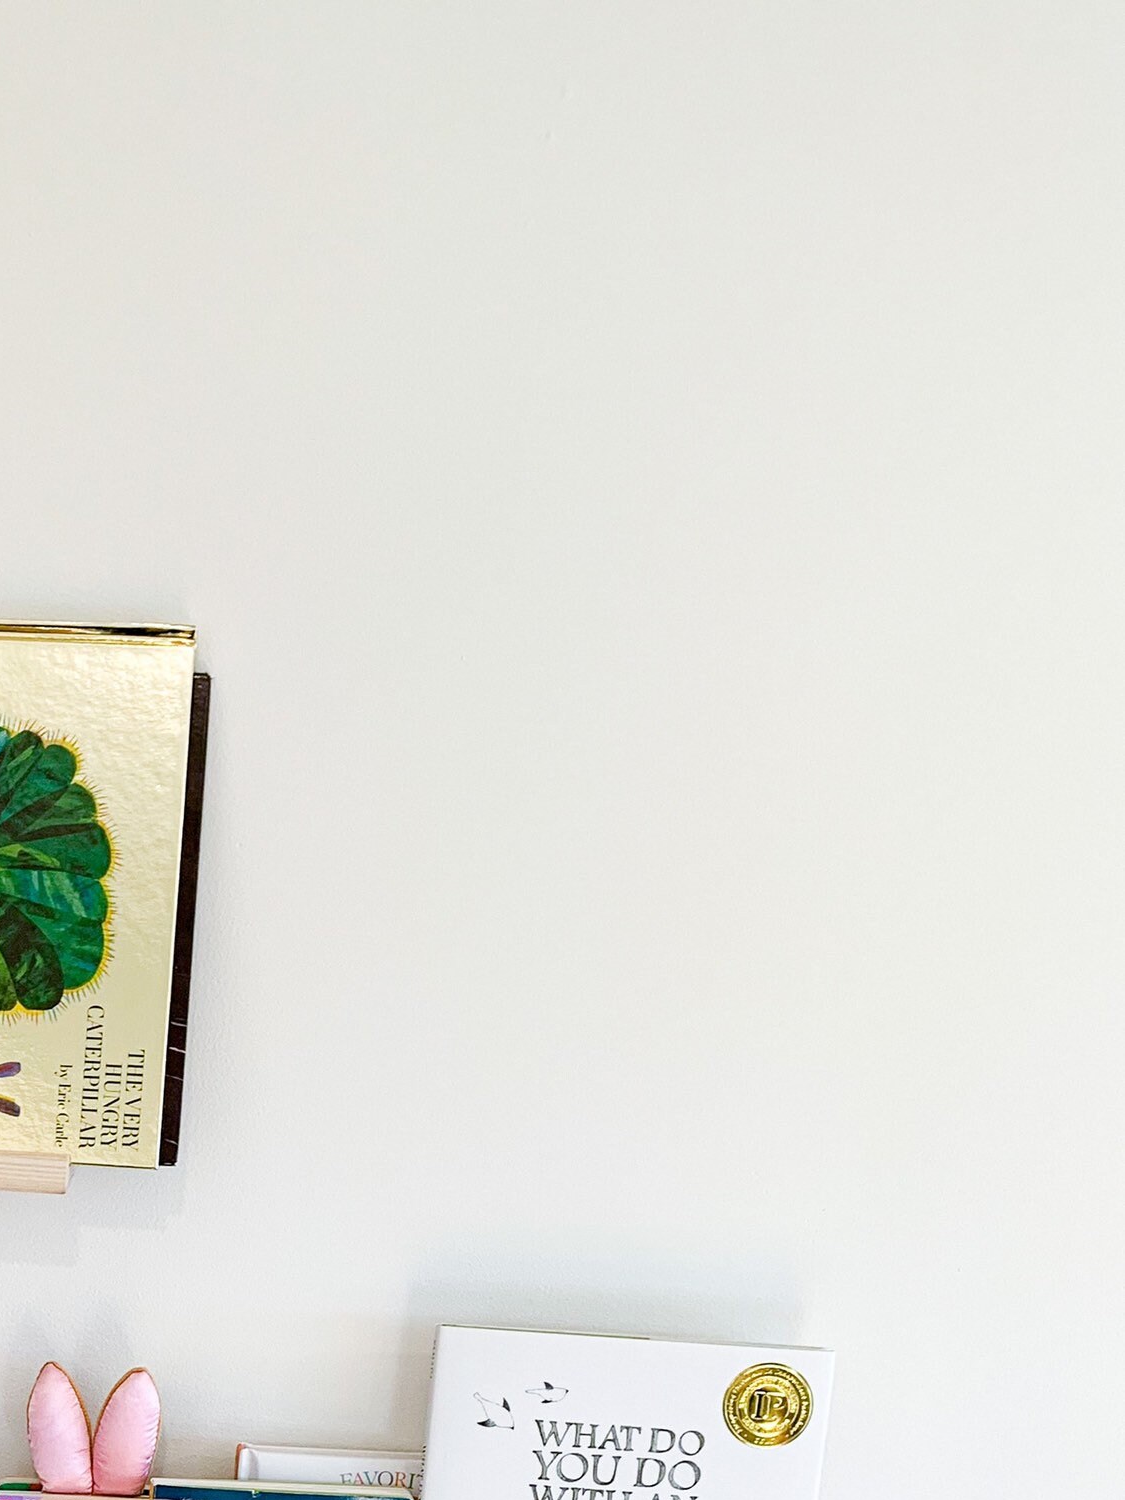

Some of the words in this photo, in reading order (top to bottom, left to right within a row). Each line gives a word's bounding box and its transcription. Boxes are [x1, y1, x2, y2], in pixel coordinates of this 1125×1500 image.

[54, 1064, 73, 1079] by
[78, 1004, 106, 1149] CATERPILLAR
[124, 1049, 146, 1093] THE
[57, 1084, 72, 1109] Eric
[99, 1063, 123, 1151] HUNGRY
[55, 1112, 70, 1148] Carle
[121, 1097, 142, 1152] VERY
[534, 1418, 642, 1453] WHAT
[648, 1427, 706, 1457] DO
[531, 1449, 622, 1487] YOU
[632, 1456, 702, 1491] DO
